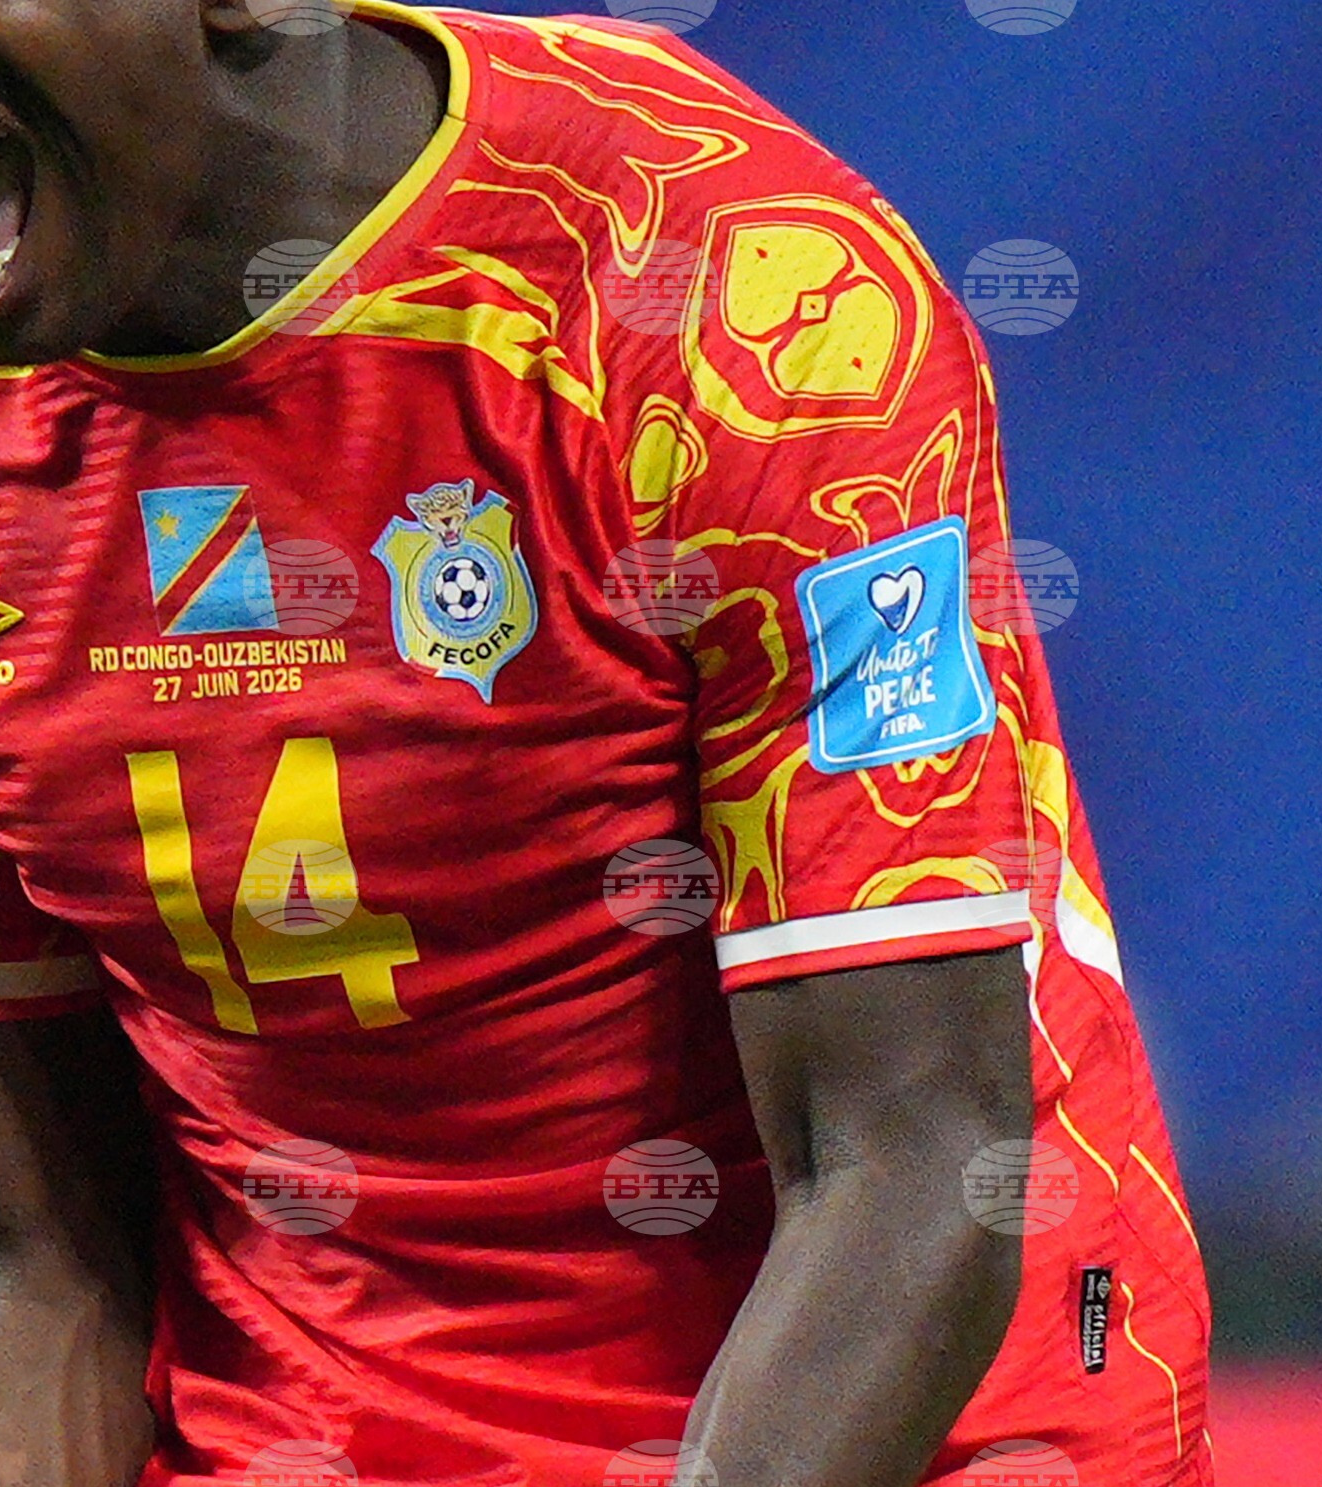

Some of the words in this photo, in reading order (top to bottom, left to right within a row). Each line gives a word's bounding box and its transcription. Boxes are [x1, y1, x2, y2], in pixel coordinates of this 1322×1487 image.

[89, 646, 119, 672] RD
[122, 638, 347, 671] CONGO-OUZBEKISTAN
[428, 620, 515, 665] FECOFA
[152, 676, 182, 702] 27
[191, 670, 240, 699] JUIN
[246, 668, 302, 694] 2026
[880, 713, 925, 740] FIFA
[124, 737, 419, 1035] 14
